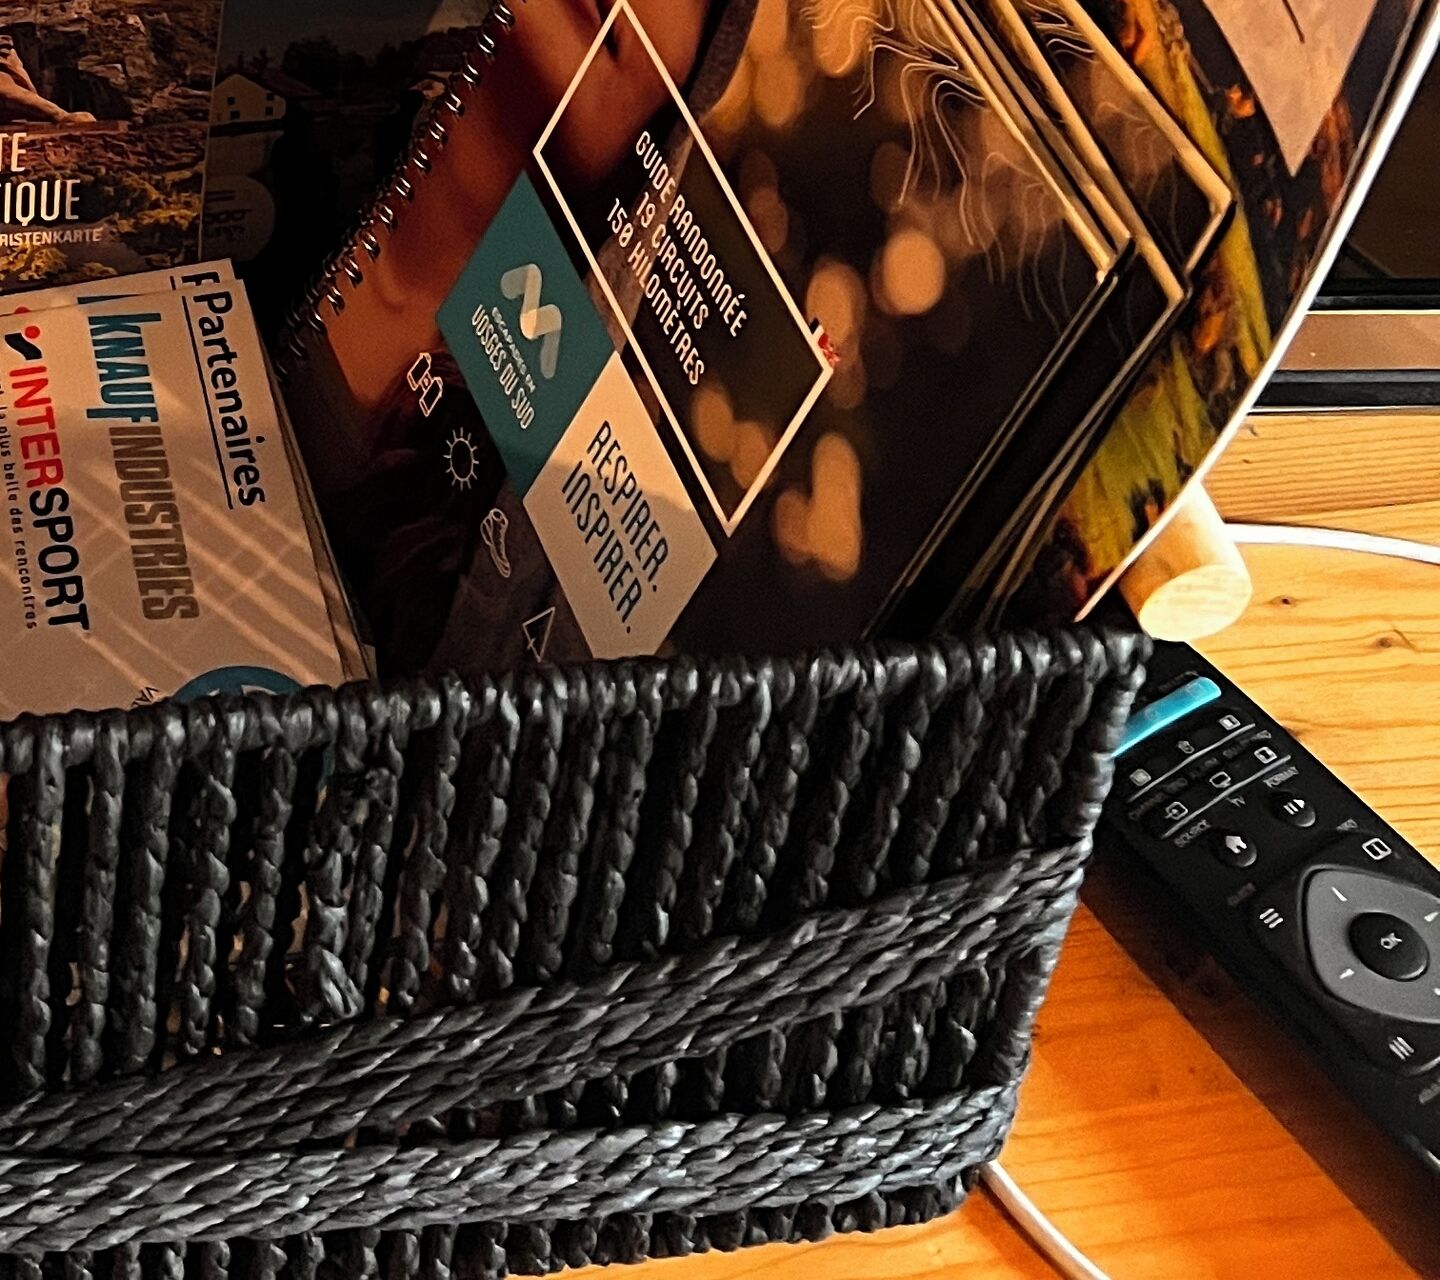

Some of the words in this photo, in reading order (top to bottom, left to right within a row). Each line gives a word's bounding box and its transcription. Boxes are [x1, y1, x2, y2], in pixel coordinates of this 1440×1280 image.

[607, 198, 634, 247] 150
[636, 131, 676, 203] GUIDE
[669, 194, 747, 337] RANDONNÉE
[636, 192, 656, 228] 19
[652, 224, 709, 329] CIRCUITS
[193, 290, 266, 507] Partenaires
[472, 304, 506, 370] VOSGES
[500, 363, 519, 395] DU
[512, 388, 534, 429] SUD
[3, 462, 17, 501] belle
[15, 540, 38, 629] rencontres
[9, 366, 89, 631] INTERSPORT
[109, 426, 199, 620] INDUSTRIES
[561, 460, 643, 633] INSPIRER.
[586, 420, 669, 591] RESPIRER.
